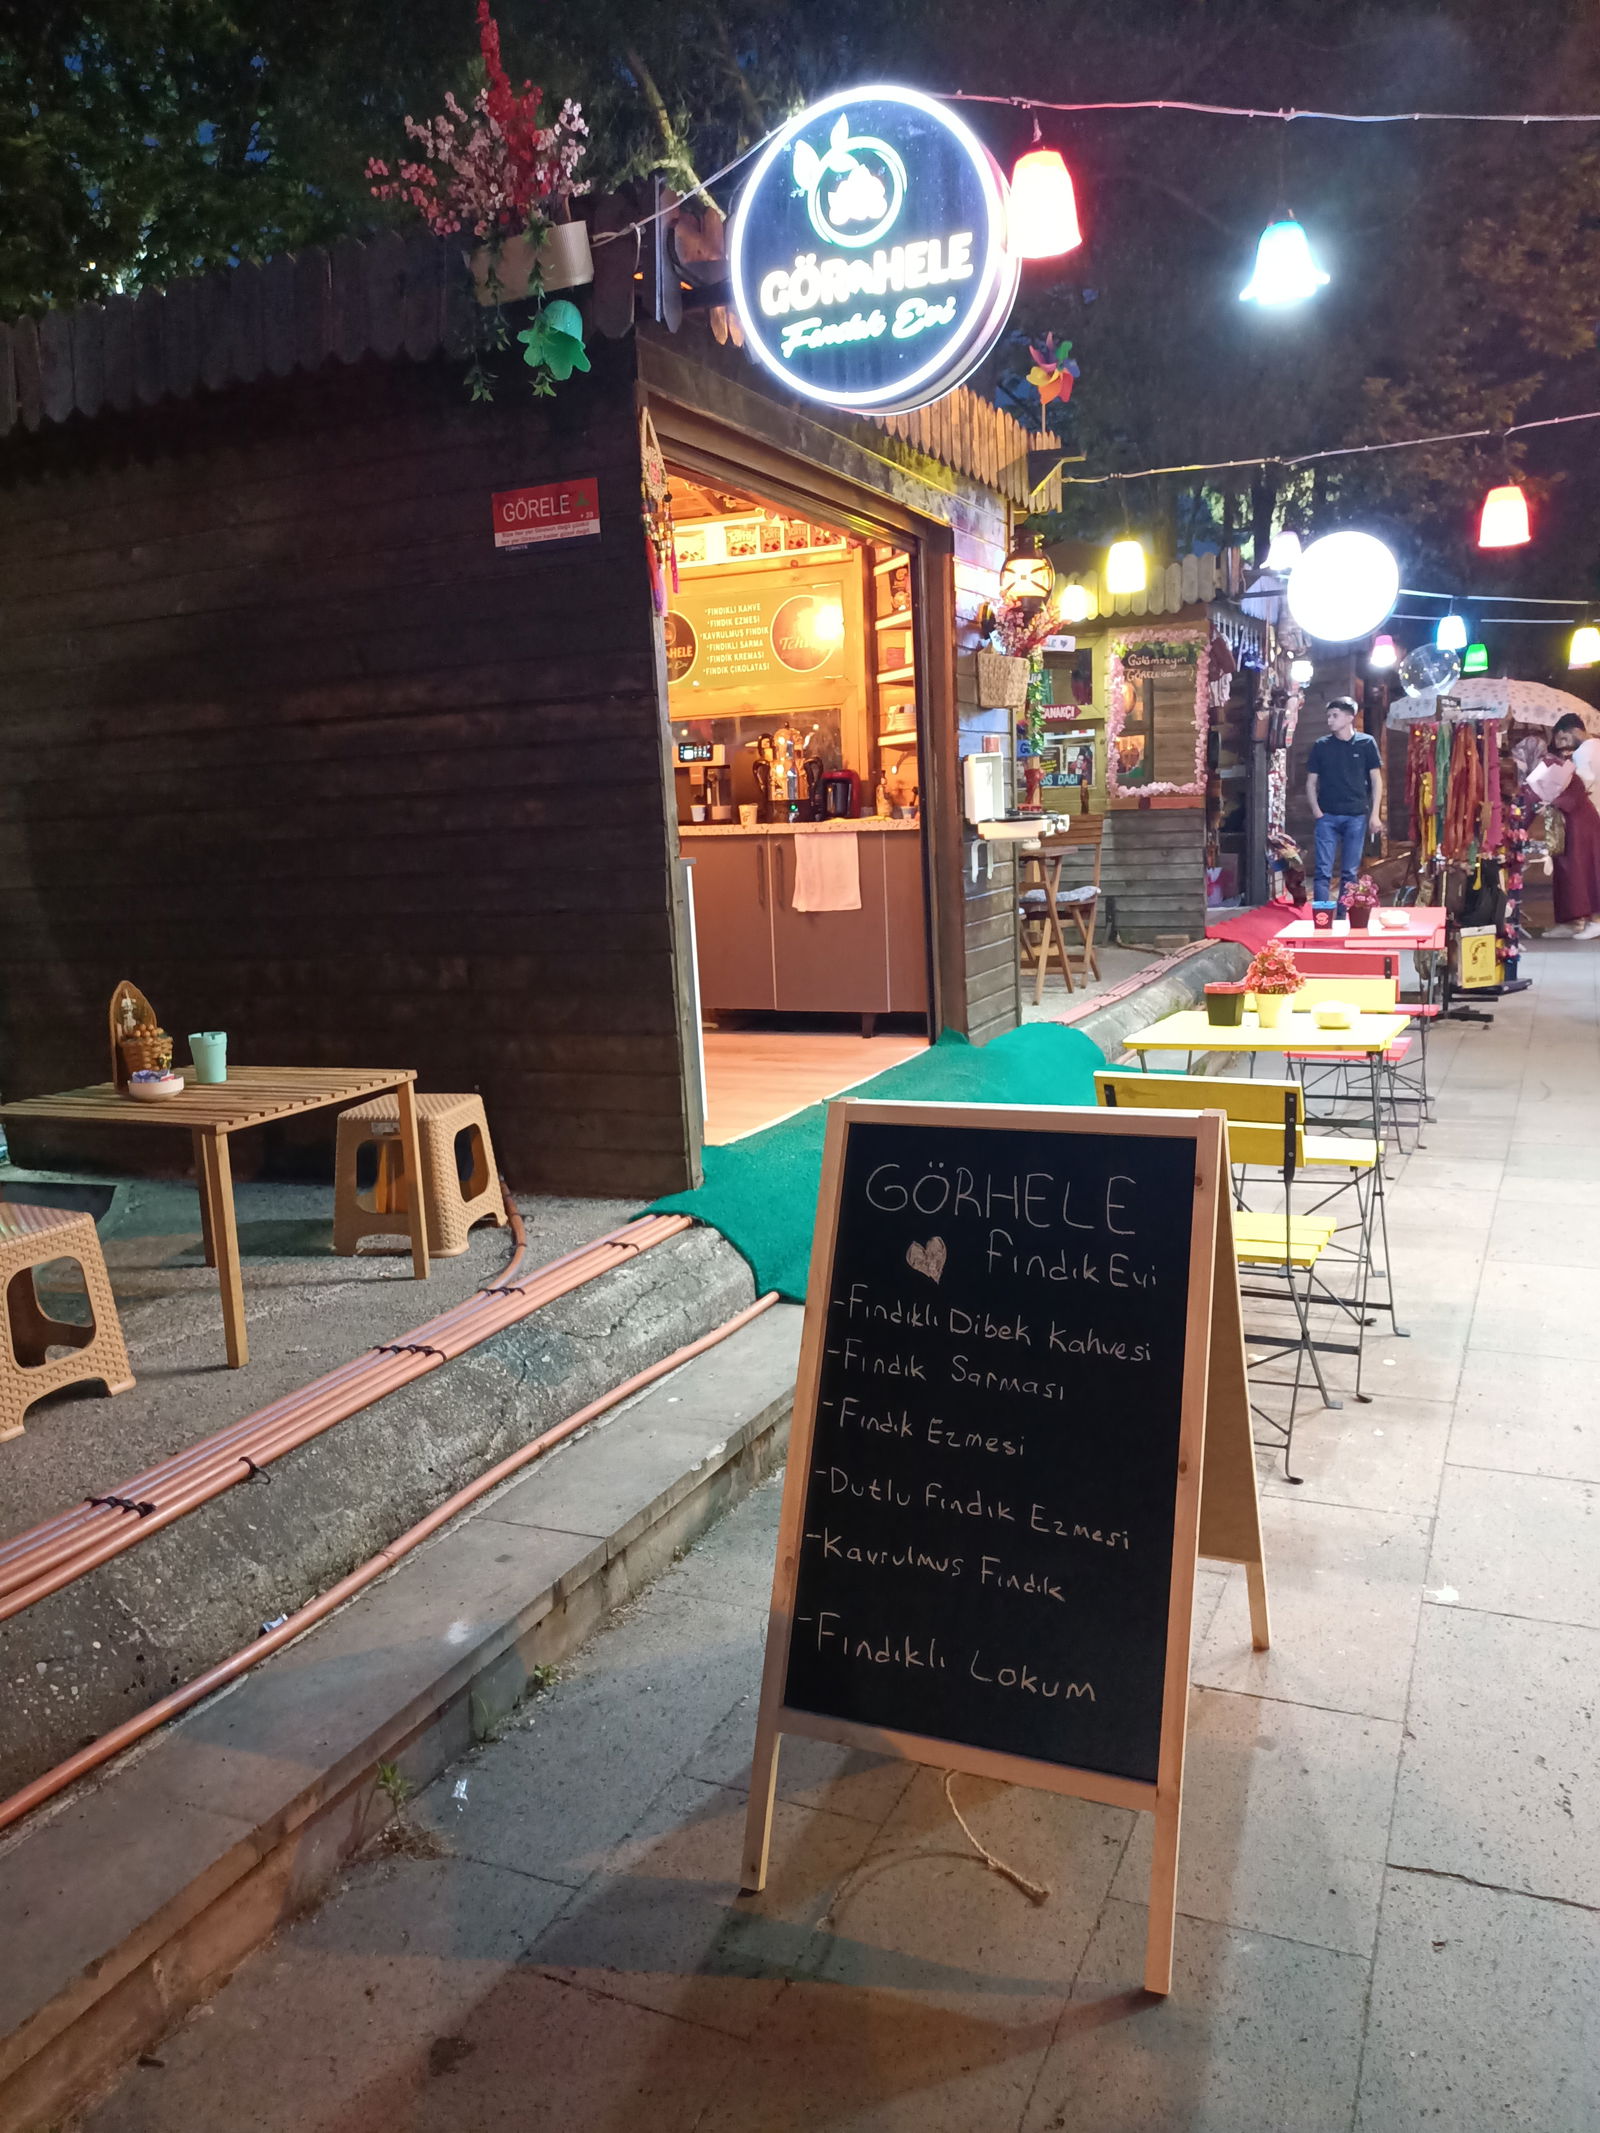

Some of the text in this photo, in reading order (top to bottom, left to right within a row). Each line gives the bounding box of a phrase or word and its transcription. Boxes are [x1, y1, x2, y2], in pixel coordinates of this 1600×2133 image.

[502, 494, 571, 522] GÖRELE
[738, 603, 761, 613] KAHVE
[740, 639, 764, 649] SARMA
[866, 1161, 1136, 1235] GÖRHELE
[950, 1309, 1031, 1346] Dibek
[1049, 1320, 1151, 1361] Kahvesi
[951, 1355, 1064, 1401] Sarması
[928, 1417, 1024, 1456] Ezmesi
[1031, 1504, 1129, 1549] Ezmesi
[981, 1556, 1065, 1602] Fındık
[970, 1649, 1096, 1702] Lokum
